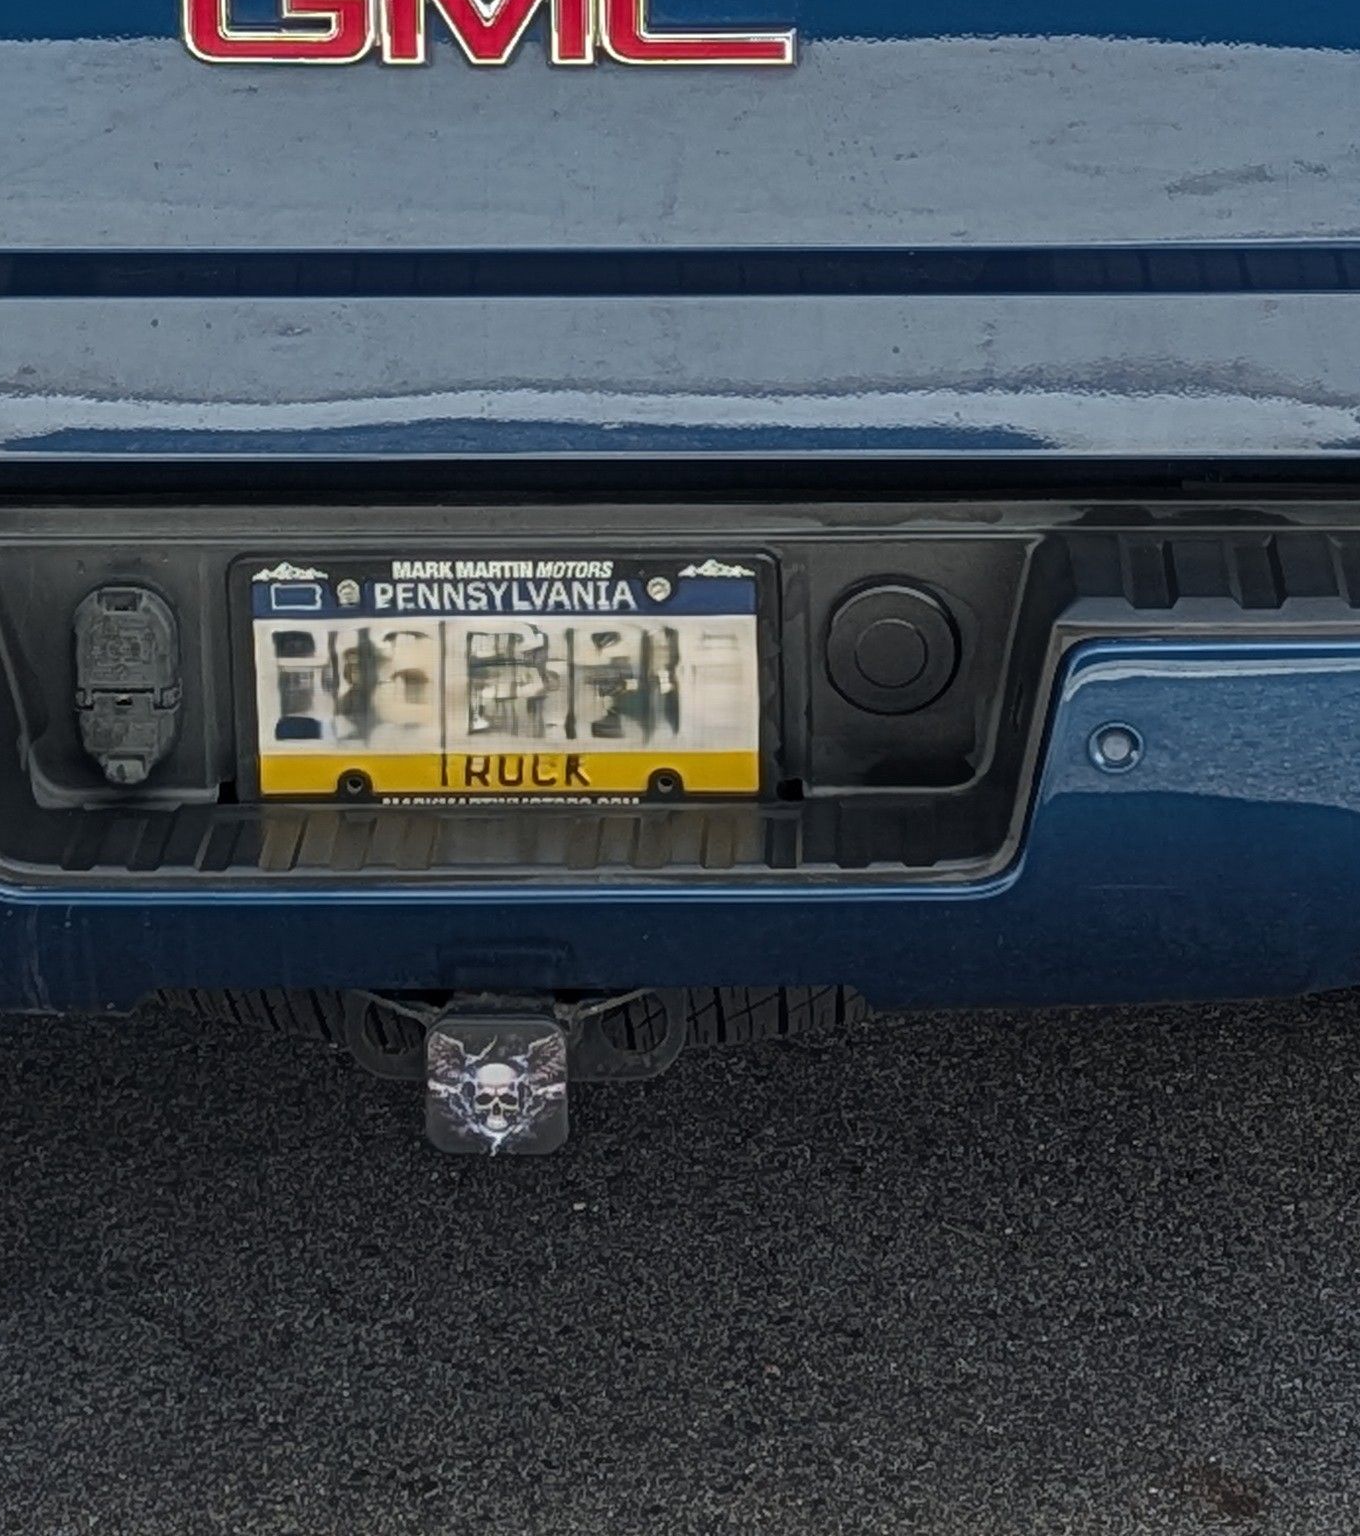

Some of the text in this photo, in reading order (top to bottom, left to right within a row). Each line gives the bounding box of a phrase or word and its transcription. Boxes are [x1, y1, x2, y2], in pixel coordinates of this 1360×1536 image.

[392, 560, 614, 580] MARK MARTIN MOTORS
[374, 580, 639, 611] PENNSYLVANIA
